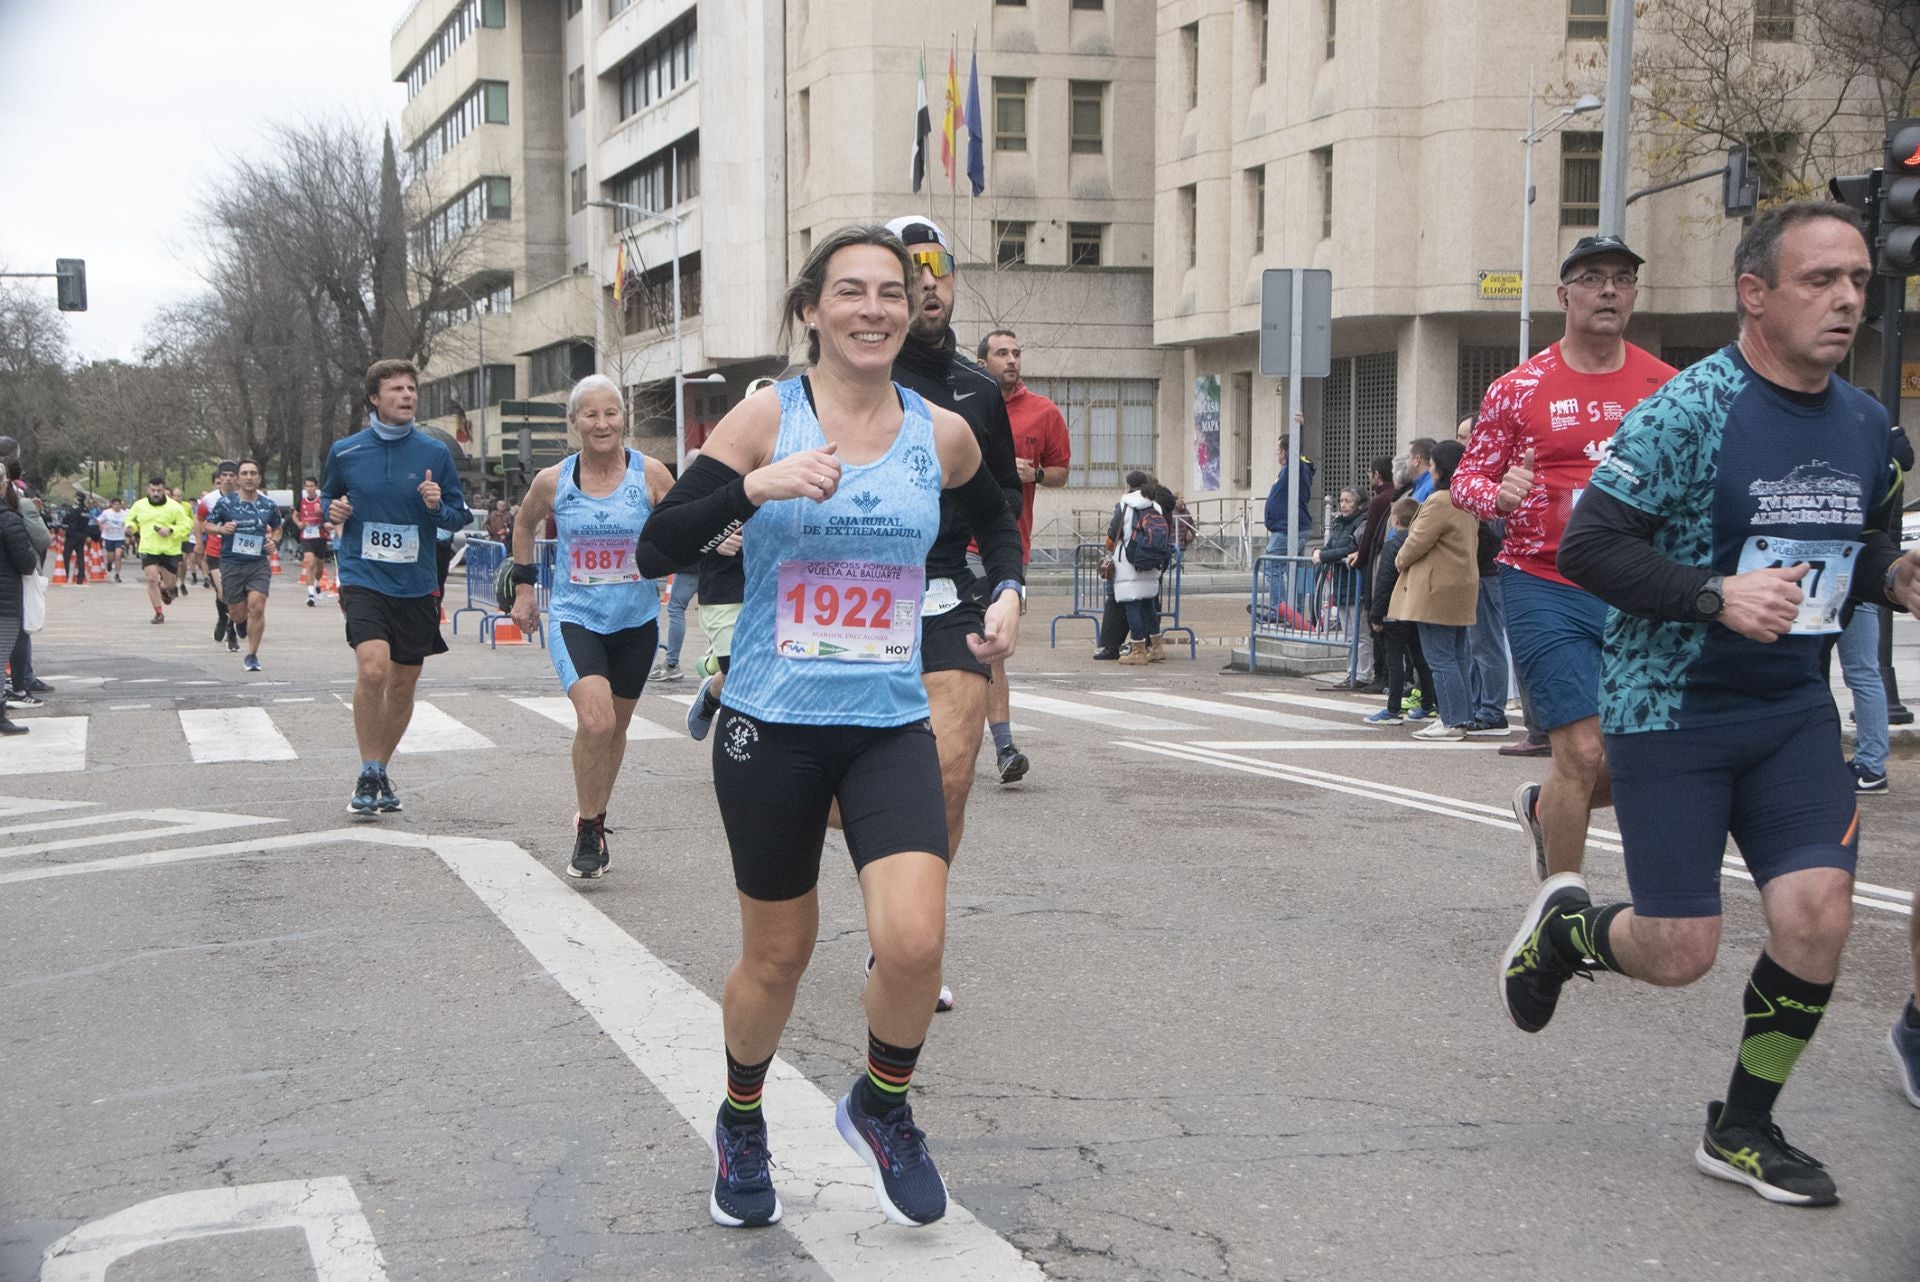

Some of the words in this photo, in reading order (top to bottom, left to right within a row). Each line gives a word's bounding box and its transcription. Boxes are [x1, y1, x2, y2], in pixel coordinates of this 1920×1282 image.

[1202, 420, 1219, 432] MAPA
[829, 516, 859, 526] CAJA
[860, 516, 903, 527] RURAL
[699, 519, 743, 554] KIPRUN
[803, 525, 820, 535] DE
[825, 526, 922, 539] EXTREMADURA
[238, 537, 255, 548] 786
[371, 531, 403, 549] 883
[571, 549, 626, 570] 1887
[826, 561, 860, 570] CROSS
[863, 562, 903, 571] POPULAR
[807, 567, 843, 576] VUELTA
[845, 568, 857, 578] AL
[860, 569, 901, 580] BALUARTE
[786, 582, 892, 629] 1922
[885, 645, 910, 655] HOY
